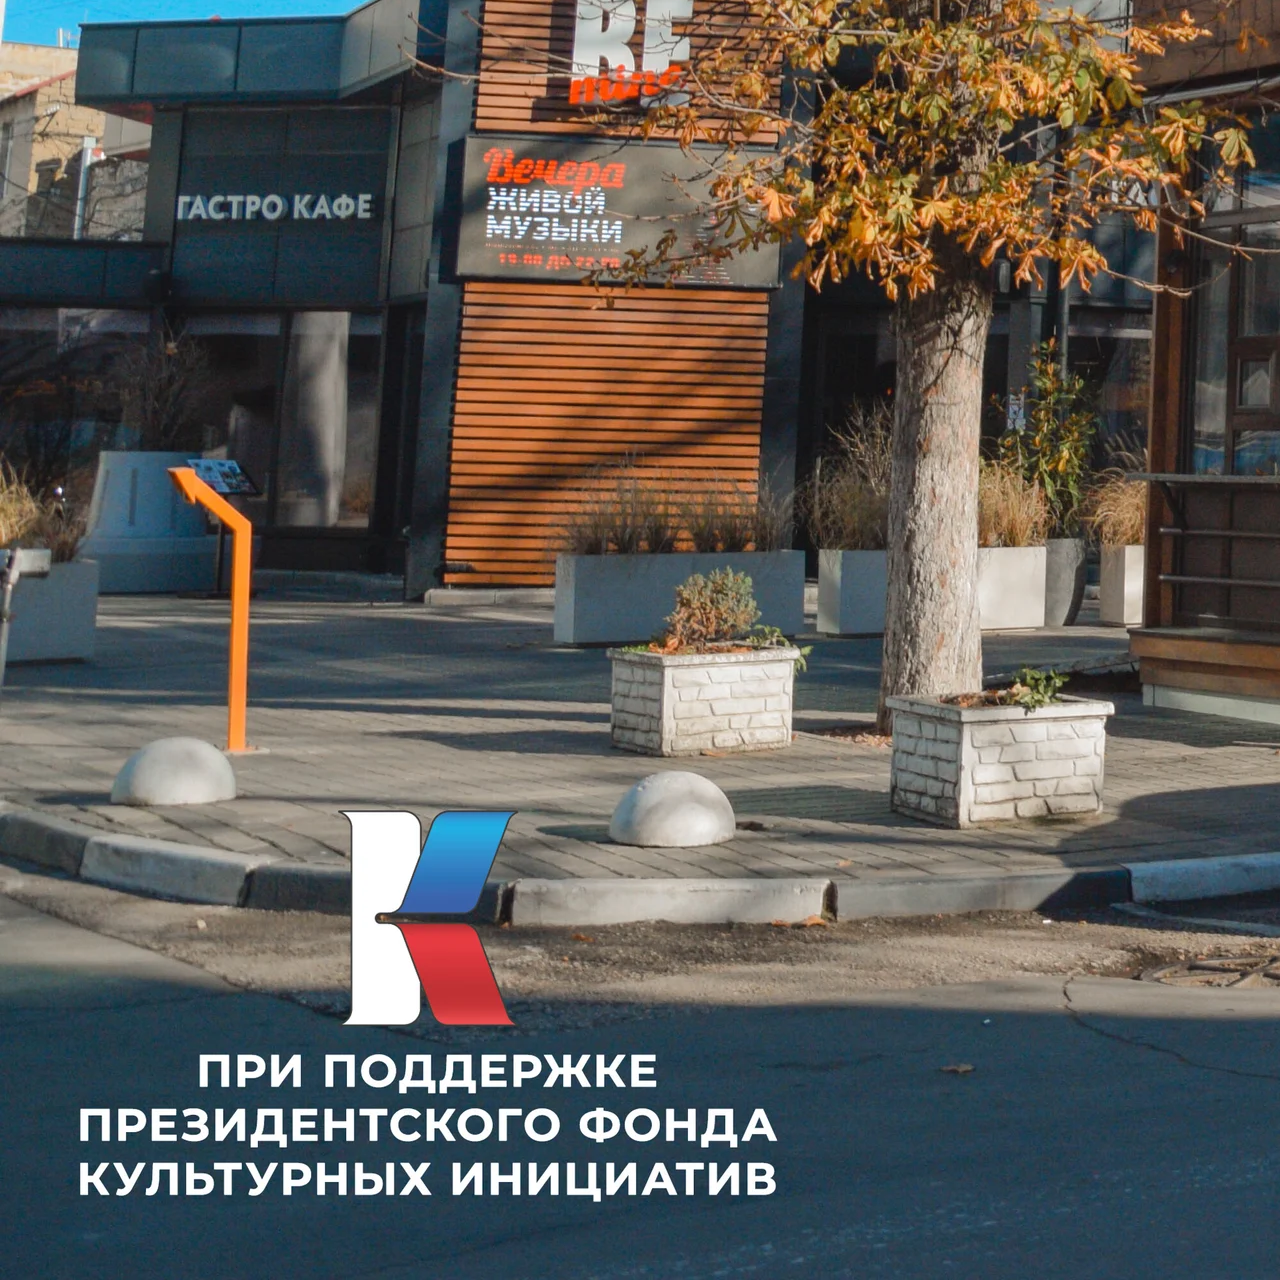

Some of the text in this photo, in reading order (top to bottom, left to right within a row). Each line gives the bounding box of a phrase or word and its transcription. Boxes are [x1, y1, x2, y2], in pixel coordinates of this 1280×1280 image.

[483, 147, 628, 202] Вечера
[177, 193, 373, 221] ГАСТРО КАФЕ
[486, 187, 606, 214] ЖИВОЙ
[486, 214, 623, 243] МУЗЫКИ
